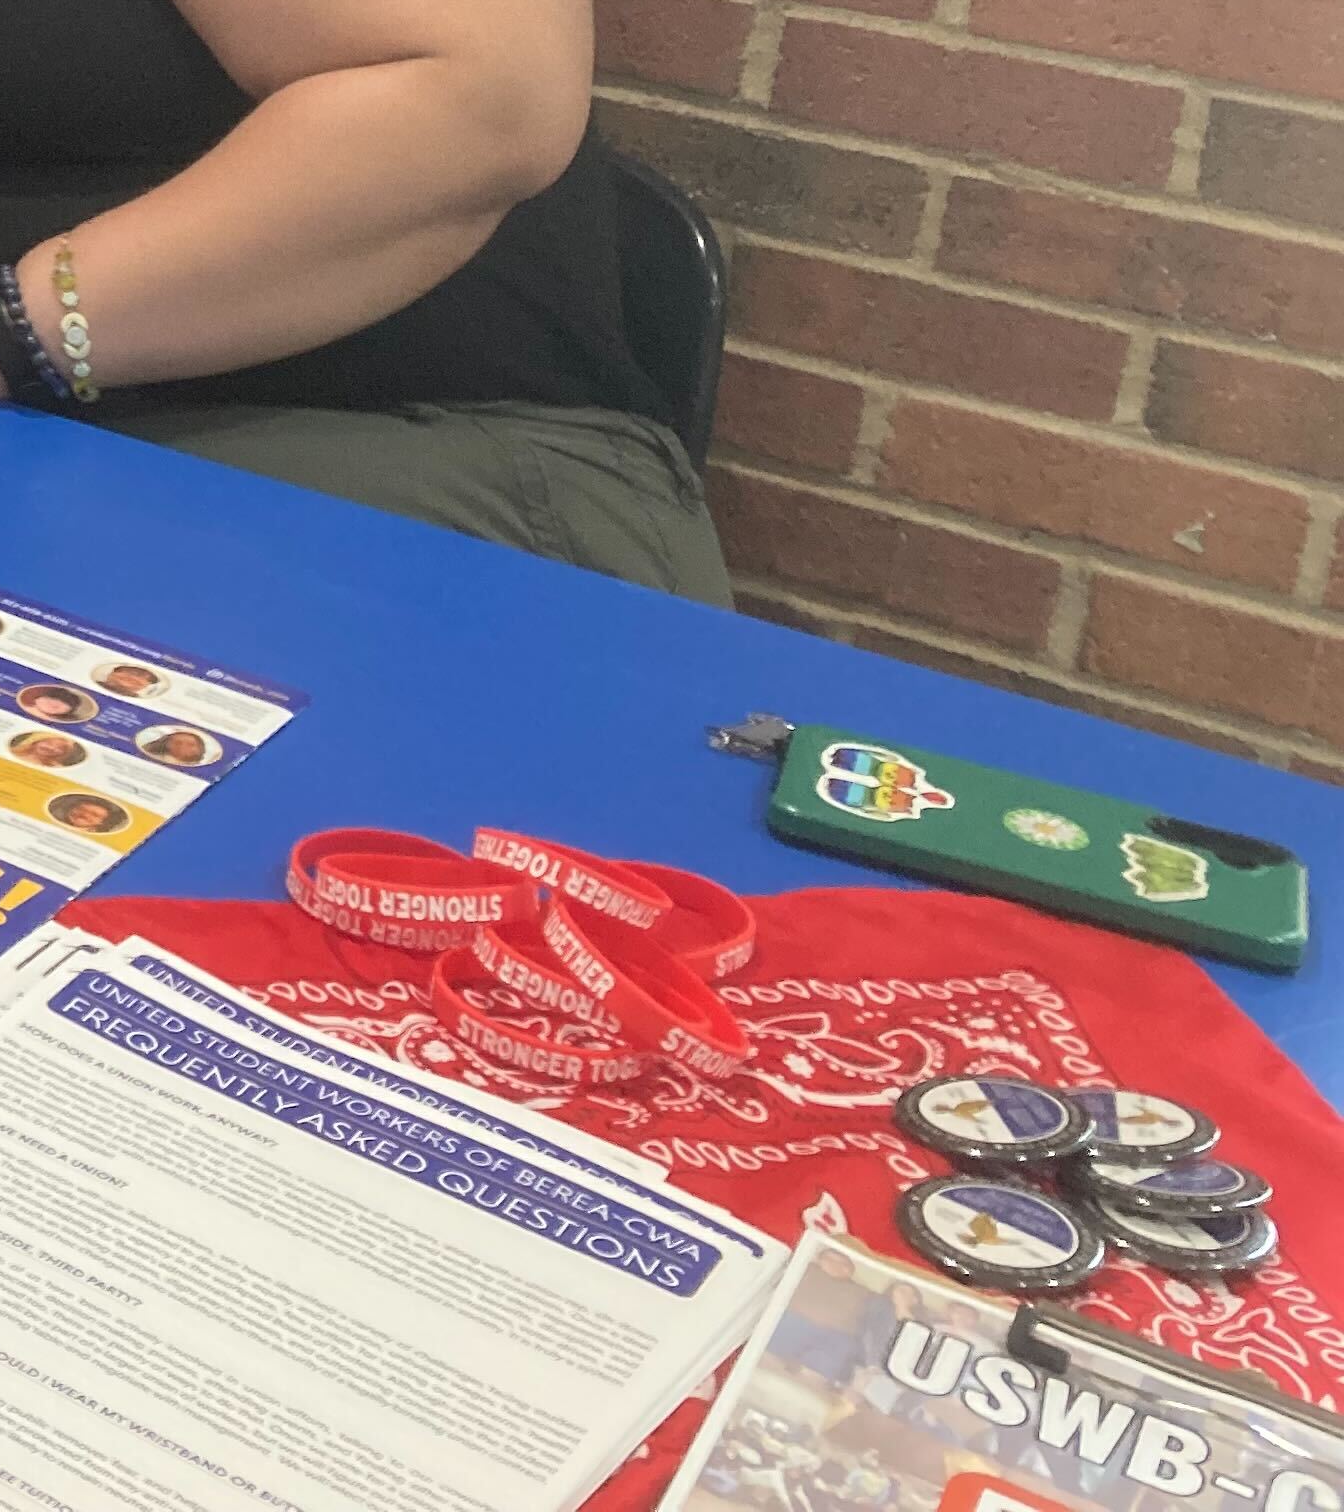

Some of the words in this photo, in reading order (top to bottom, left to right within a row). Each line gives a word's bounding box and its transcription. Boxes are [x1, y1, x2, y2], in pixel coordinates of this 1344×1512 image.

[378, 889, 503, 923] STRONGER
[564, 868, 662, 930] STRONGER
[141, 961, 238, 1024] UNITED
[242, 1016, 367, 1083] STUDENT
[495, 954, 622, 1034] STRONGER
[15, 1021, 56, 1043] HOW
[107, 1066, 157, 1093] UNION
[457, 1013, 582, 1082] STRONGER
[660, 1028, 741, 1079] STRON
[58, 997, 300, 1119] FREQUENTLY
[292, 1107, 433, 1180] ASKED
[428, 1166, 689, 1290] QUESTIONS
[85, 977, 191, 1034] UNITED
[183, 1027, 317, 1092] STUDENT
[309, 1084, 464, 1155] WORKERS
[457, 1145, 515, 1177] OF
[510, 1167, 709, 1263] BEREA-CWA
[16, 1132, 60, 1157] NEED
[68, 1157, 130, 1190] UNION?
[34, 1249, 87, 1279] THIRD
[84, 1274, 145, 1308] PARTY?
[45, 1377, 101, 1410] WEAR
[98, 1405, 132, 1426] MY
[125, 1419, 231, 1479] WRISTBAND
[227, 1472, 262, 1495] OR
[19, 1480, 74, 1512] TUITIO
